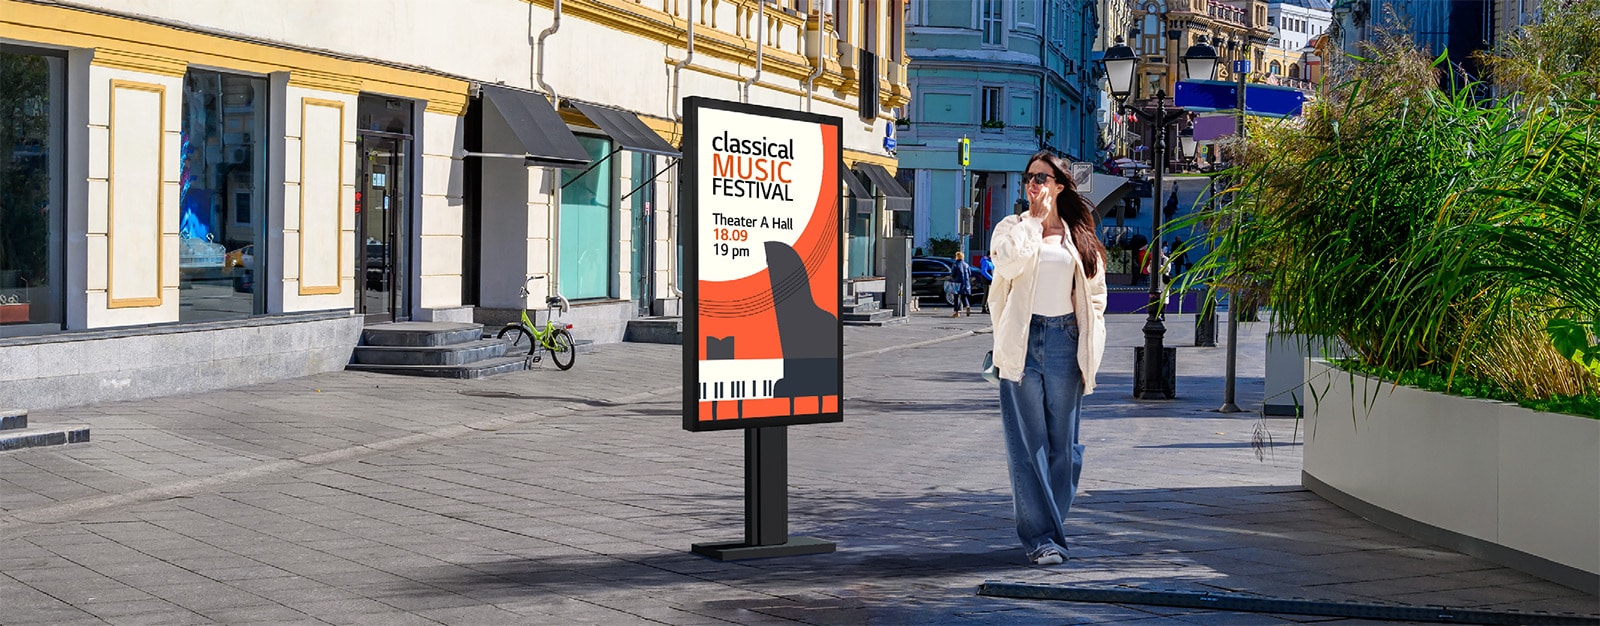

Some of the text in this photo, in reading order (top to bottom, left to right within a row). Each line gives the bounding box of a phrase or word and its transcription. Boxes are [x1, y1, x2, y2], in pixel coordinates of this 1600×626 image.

[712, 131, 794, 160] classical
[713, 153, 793, 183] MUSIC
[713, 178, 793, 202] FESTIVAL
[713, 213, 793, 230] Theater A Hall
[714, 228, 748, 242] 18.09
[714, 243, 749, 259] 19 pm
